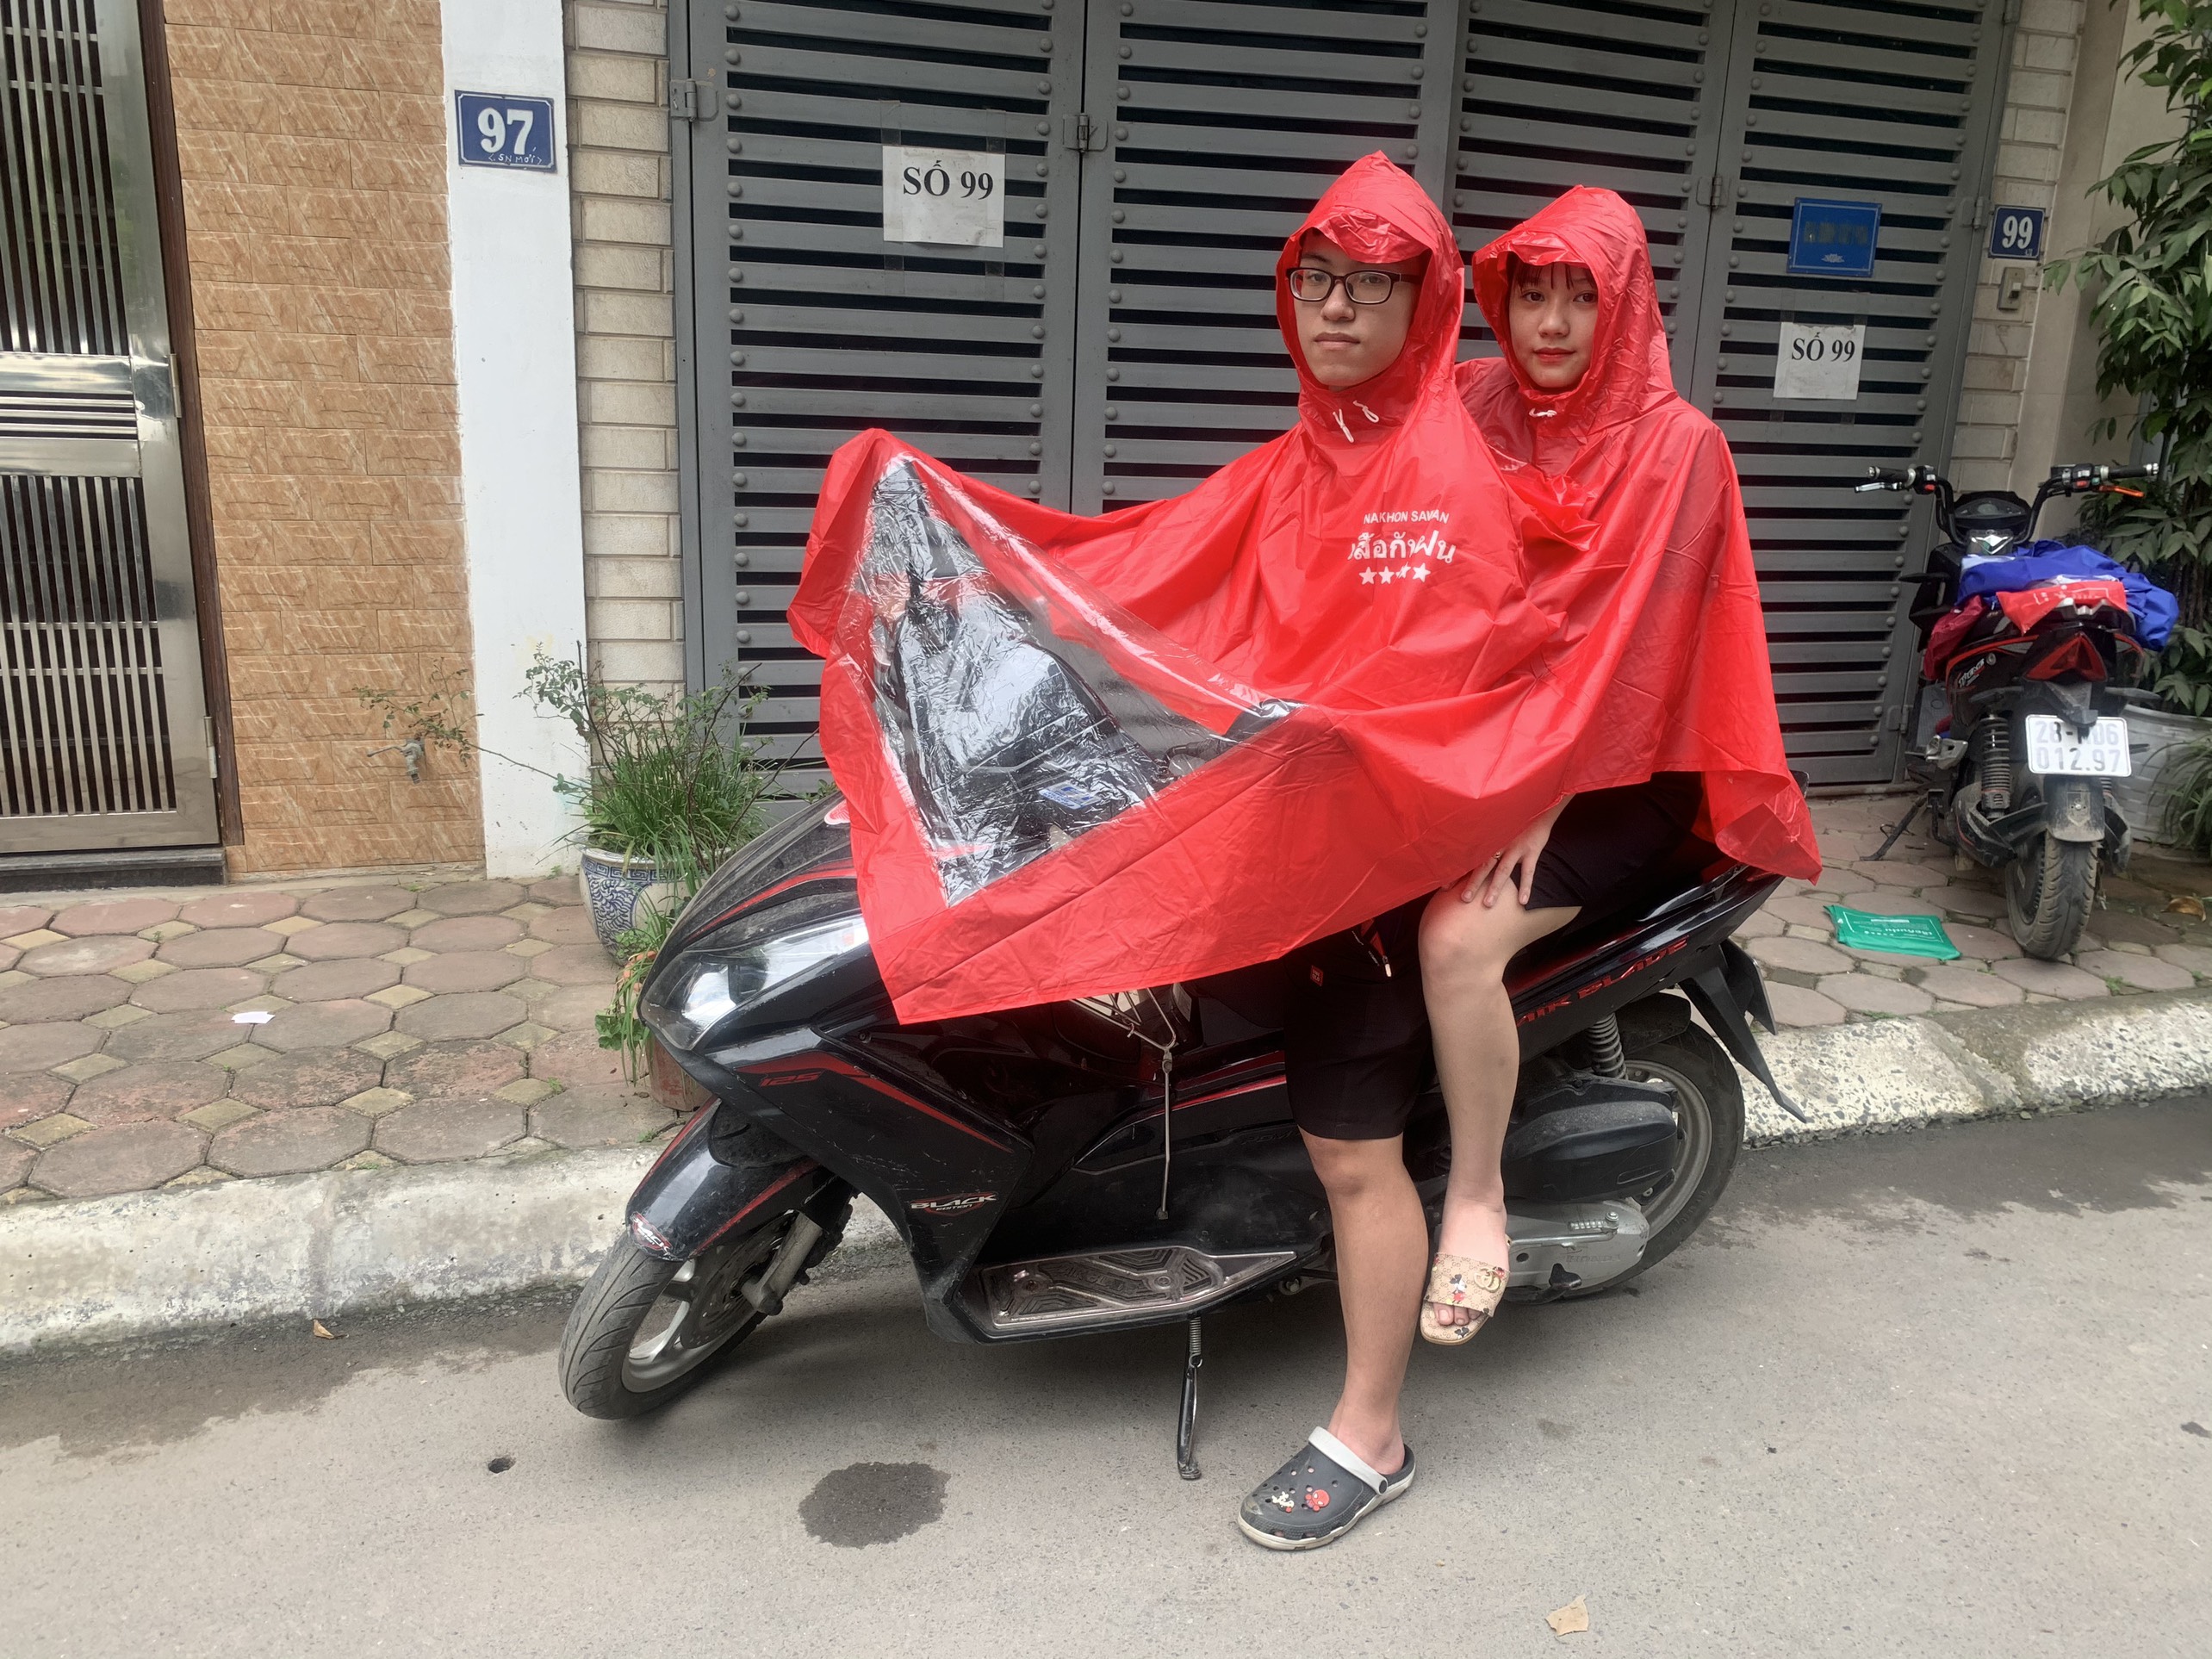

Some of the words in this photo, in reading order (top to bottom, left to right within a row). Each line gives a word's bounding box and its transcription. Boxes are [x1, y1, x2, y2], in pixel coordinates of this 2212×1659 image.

[477, 107, 534, 155] 97
[903, 160, 950, 196] SỐ
[960, 171, 994, 200] 99
[2002, 215, 2033, 249] 99
[1792, 332, 1824, 362] SỐ
[1830, 339, 1855, 362] 99
[1364, 511, 1408, 524] NAKHON
[2036, 746, 2121, 773] 012.97
[1578, 935, 1690, 999] BLADE
[910, 1194, 997, 1209] BLACK
